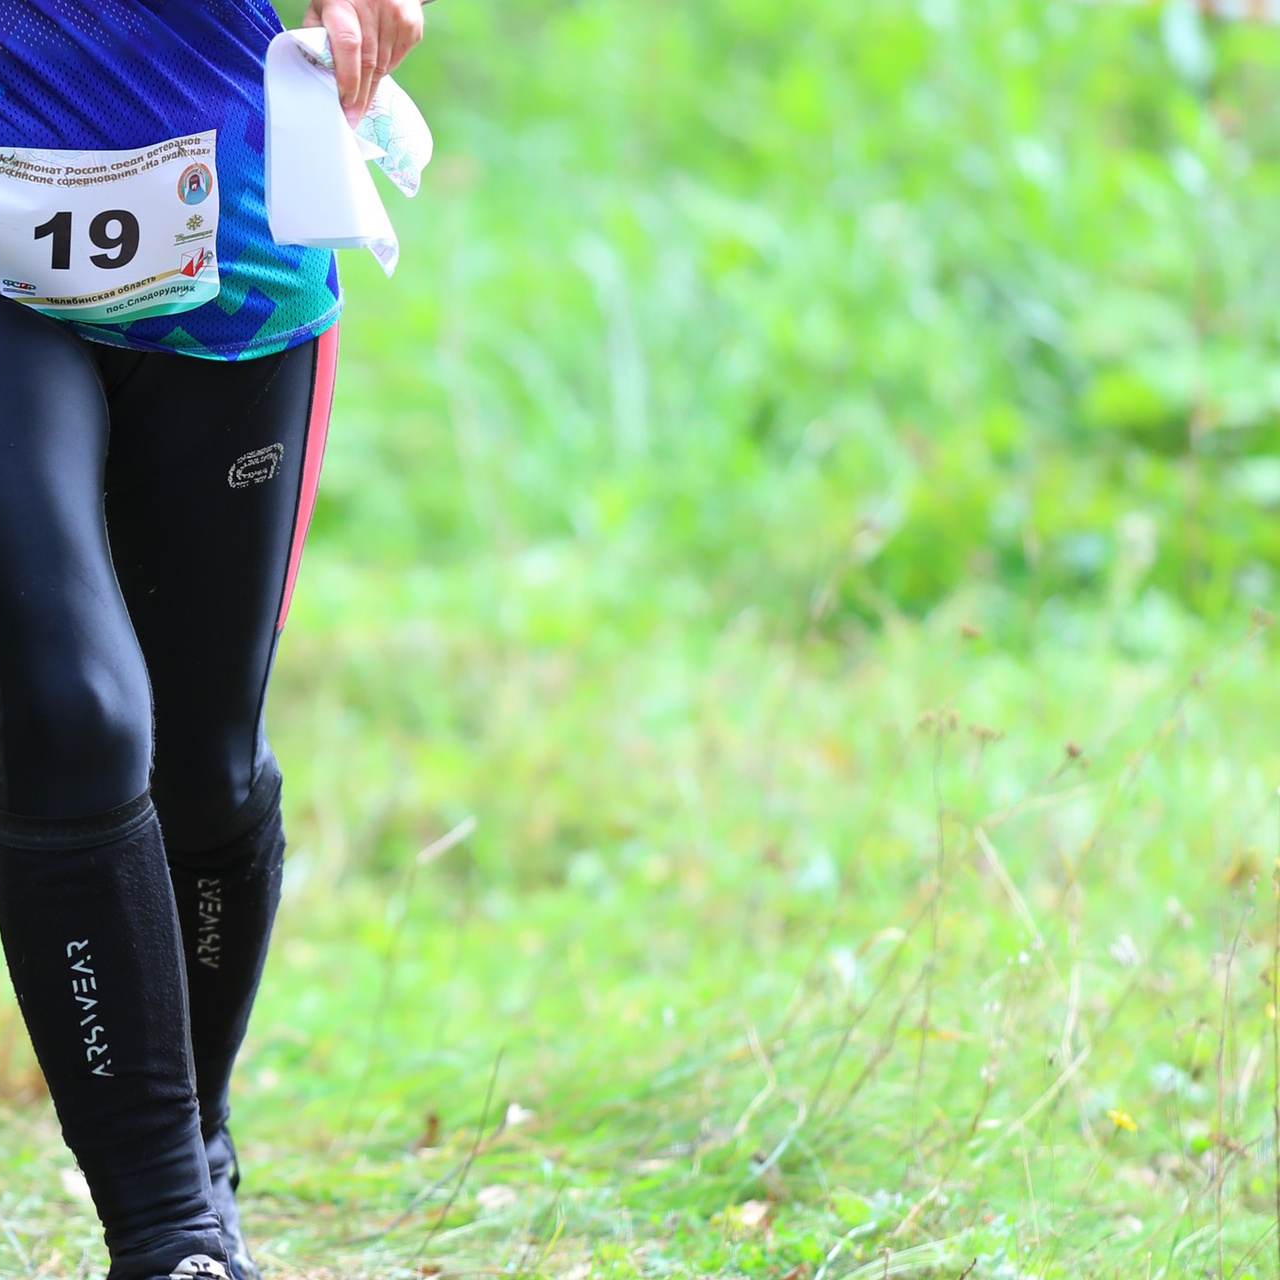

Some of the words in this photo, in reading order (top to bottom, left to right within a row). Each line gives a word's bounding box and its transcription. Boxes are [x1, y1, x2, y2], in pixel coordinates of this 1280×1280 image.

[65, 165, 107, 176] России
[110, 155, 144, 171] среди
[146, 137, 201, 159] ветеранов
[57, 168, 138, 188] соревнования
[34, 209, 140, 270] 19
[46, 290, 116, 305] Челябинская
[117, 275, 157, 295] область
